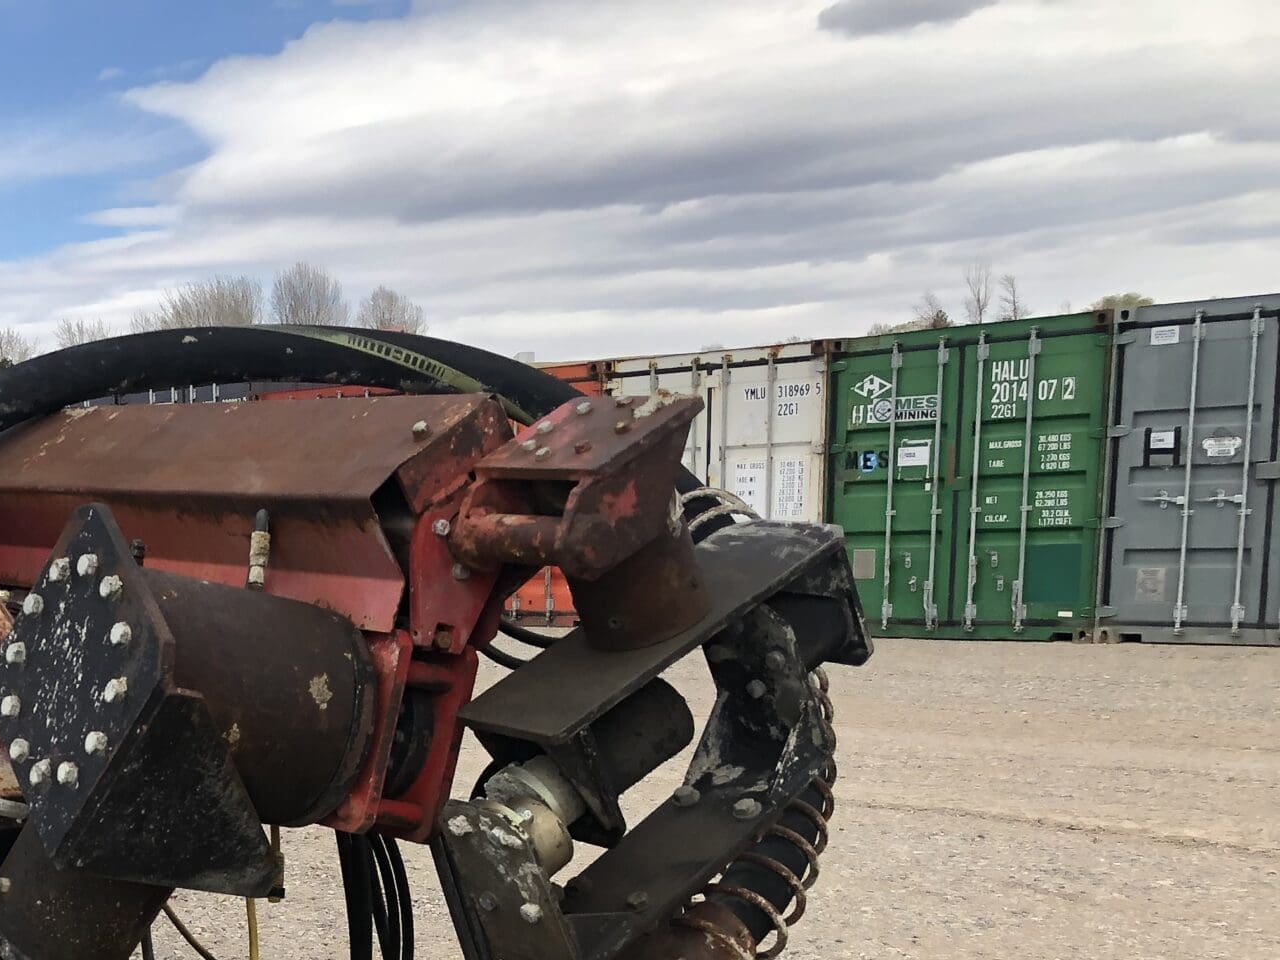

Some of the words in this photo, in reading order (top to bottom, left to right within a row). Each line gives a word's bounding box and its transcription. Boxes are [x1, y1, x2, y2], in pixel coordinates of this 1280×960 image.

[992, 359, 1029, 381] HALU
[744, 387, 766, 400] YMLU
[777, 383, 810, 398] 318969
[815, 382, 821, 395] 5
[1063, 378, 1074, 400] 2
[777, 402, 799, 416] 22G1
[895, 396, 938, 409] MES
[894, 409, 937, 420] MINING
[991, 403, 1016, 418] 22G1
